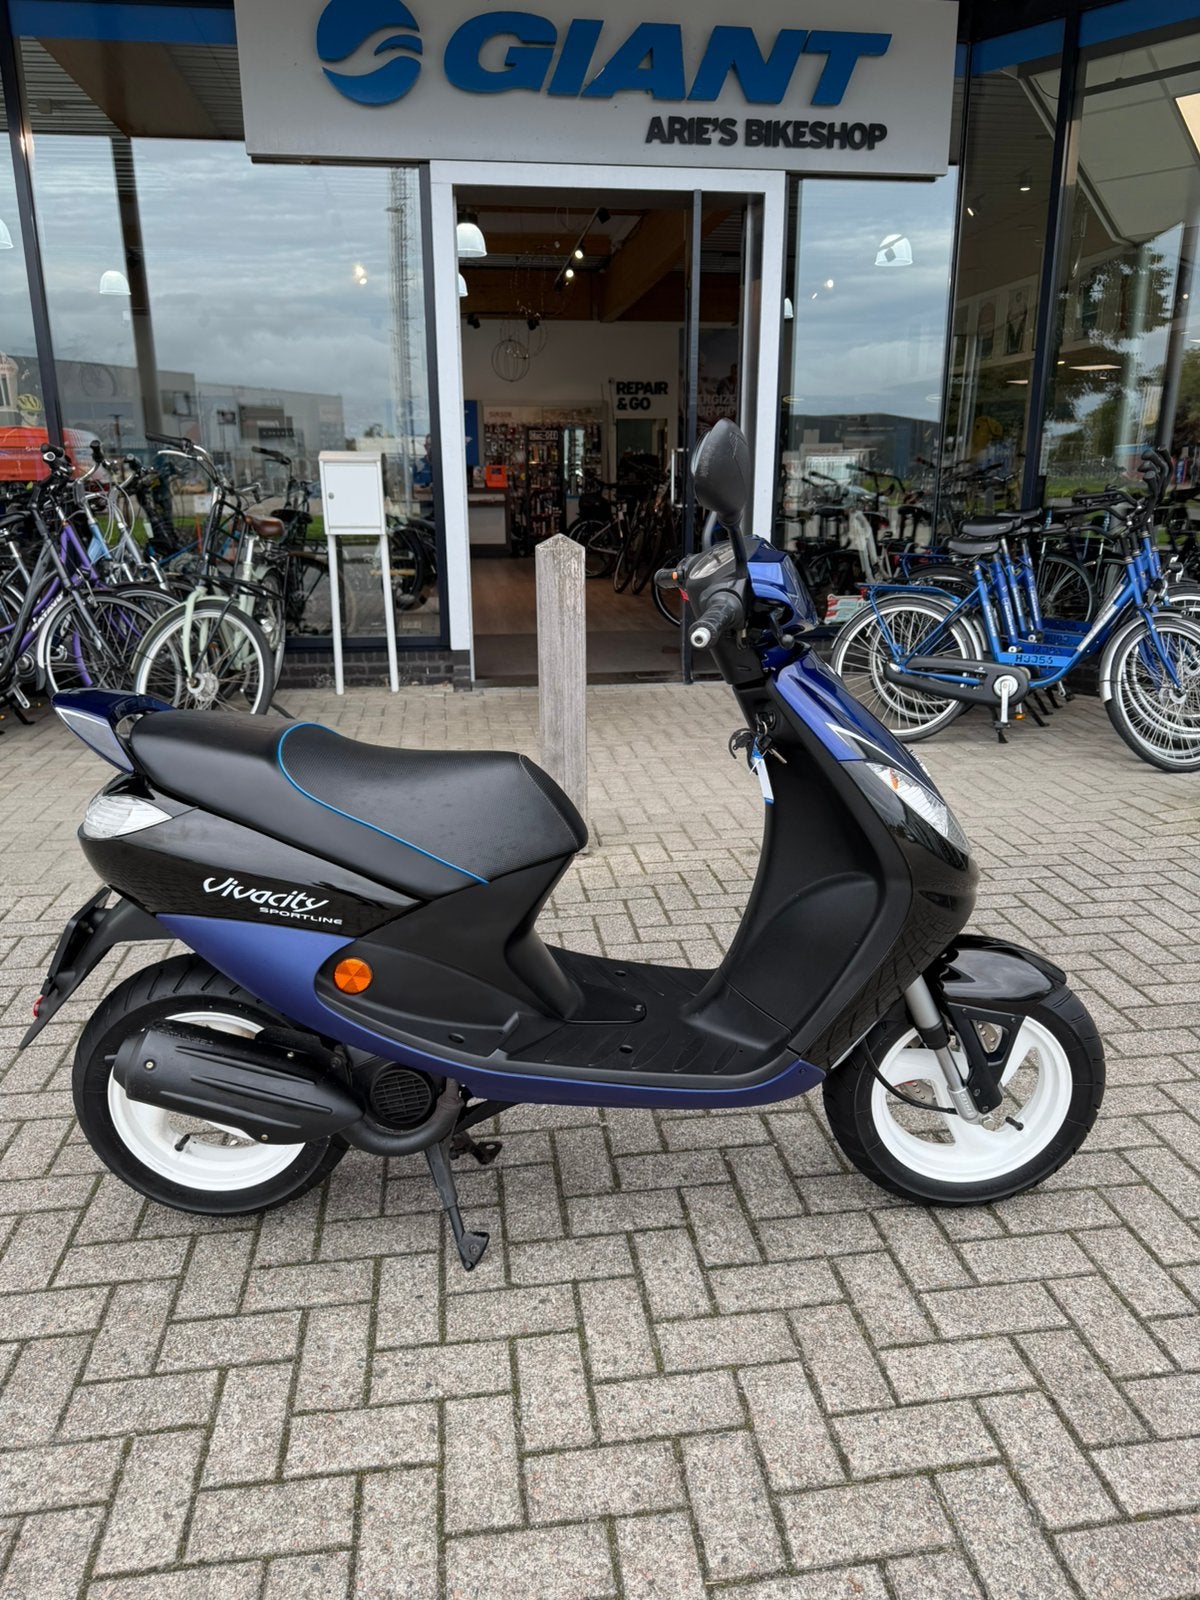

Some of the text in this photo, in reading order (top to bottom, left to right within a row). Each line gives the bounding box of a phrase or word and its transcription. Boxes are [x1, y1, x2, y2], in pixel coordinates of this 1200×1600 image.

[443, 10, 893, 106] GIANT
[645, 116, 888, 151] ARIE'S BIKESHOP
[616, 381, 669, 395] REPAIR
[616, 397, 651, 411] & GO
[31, 590, 64, 632] BATAVU
[202, 876, 330, 913] Vivacity
[259, 906, 343, 926] SPORTLINE
